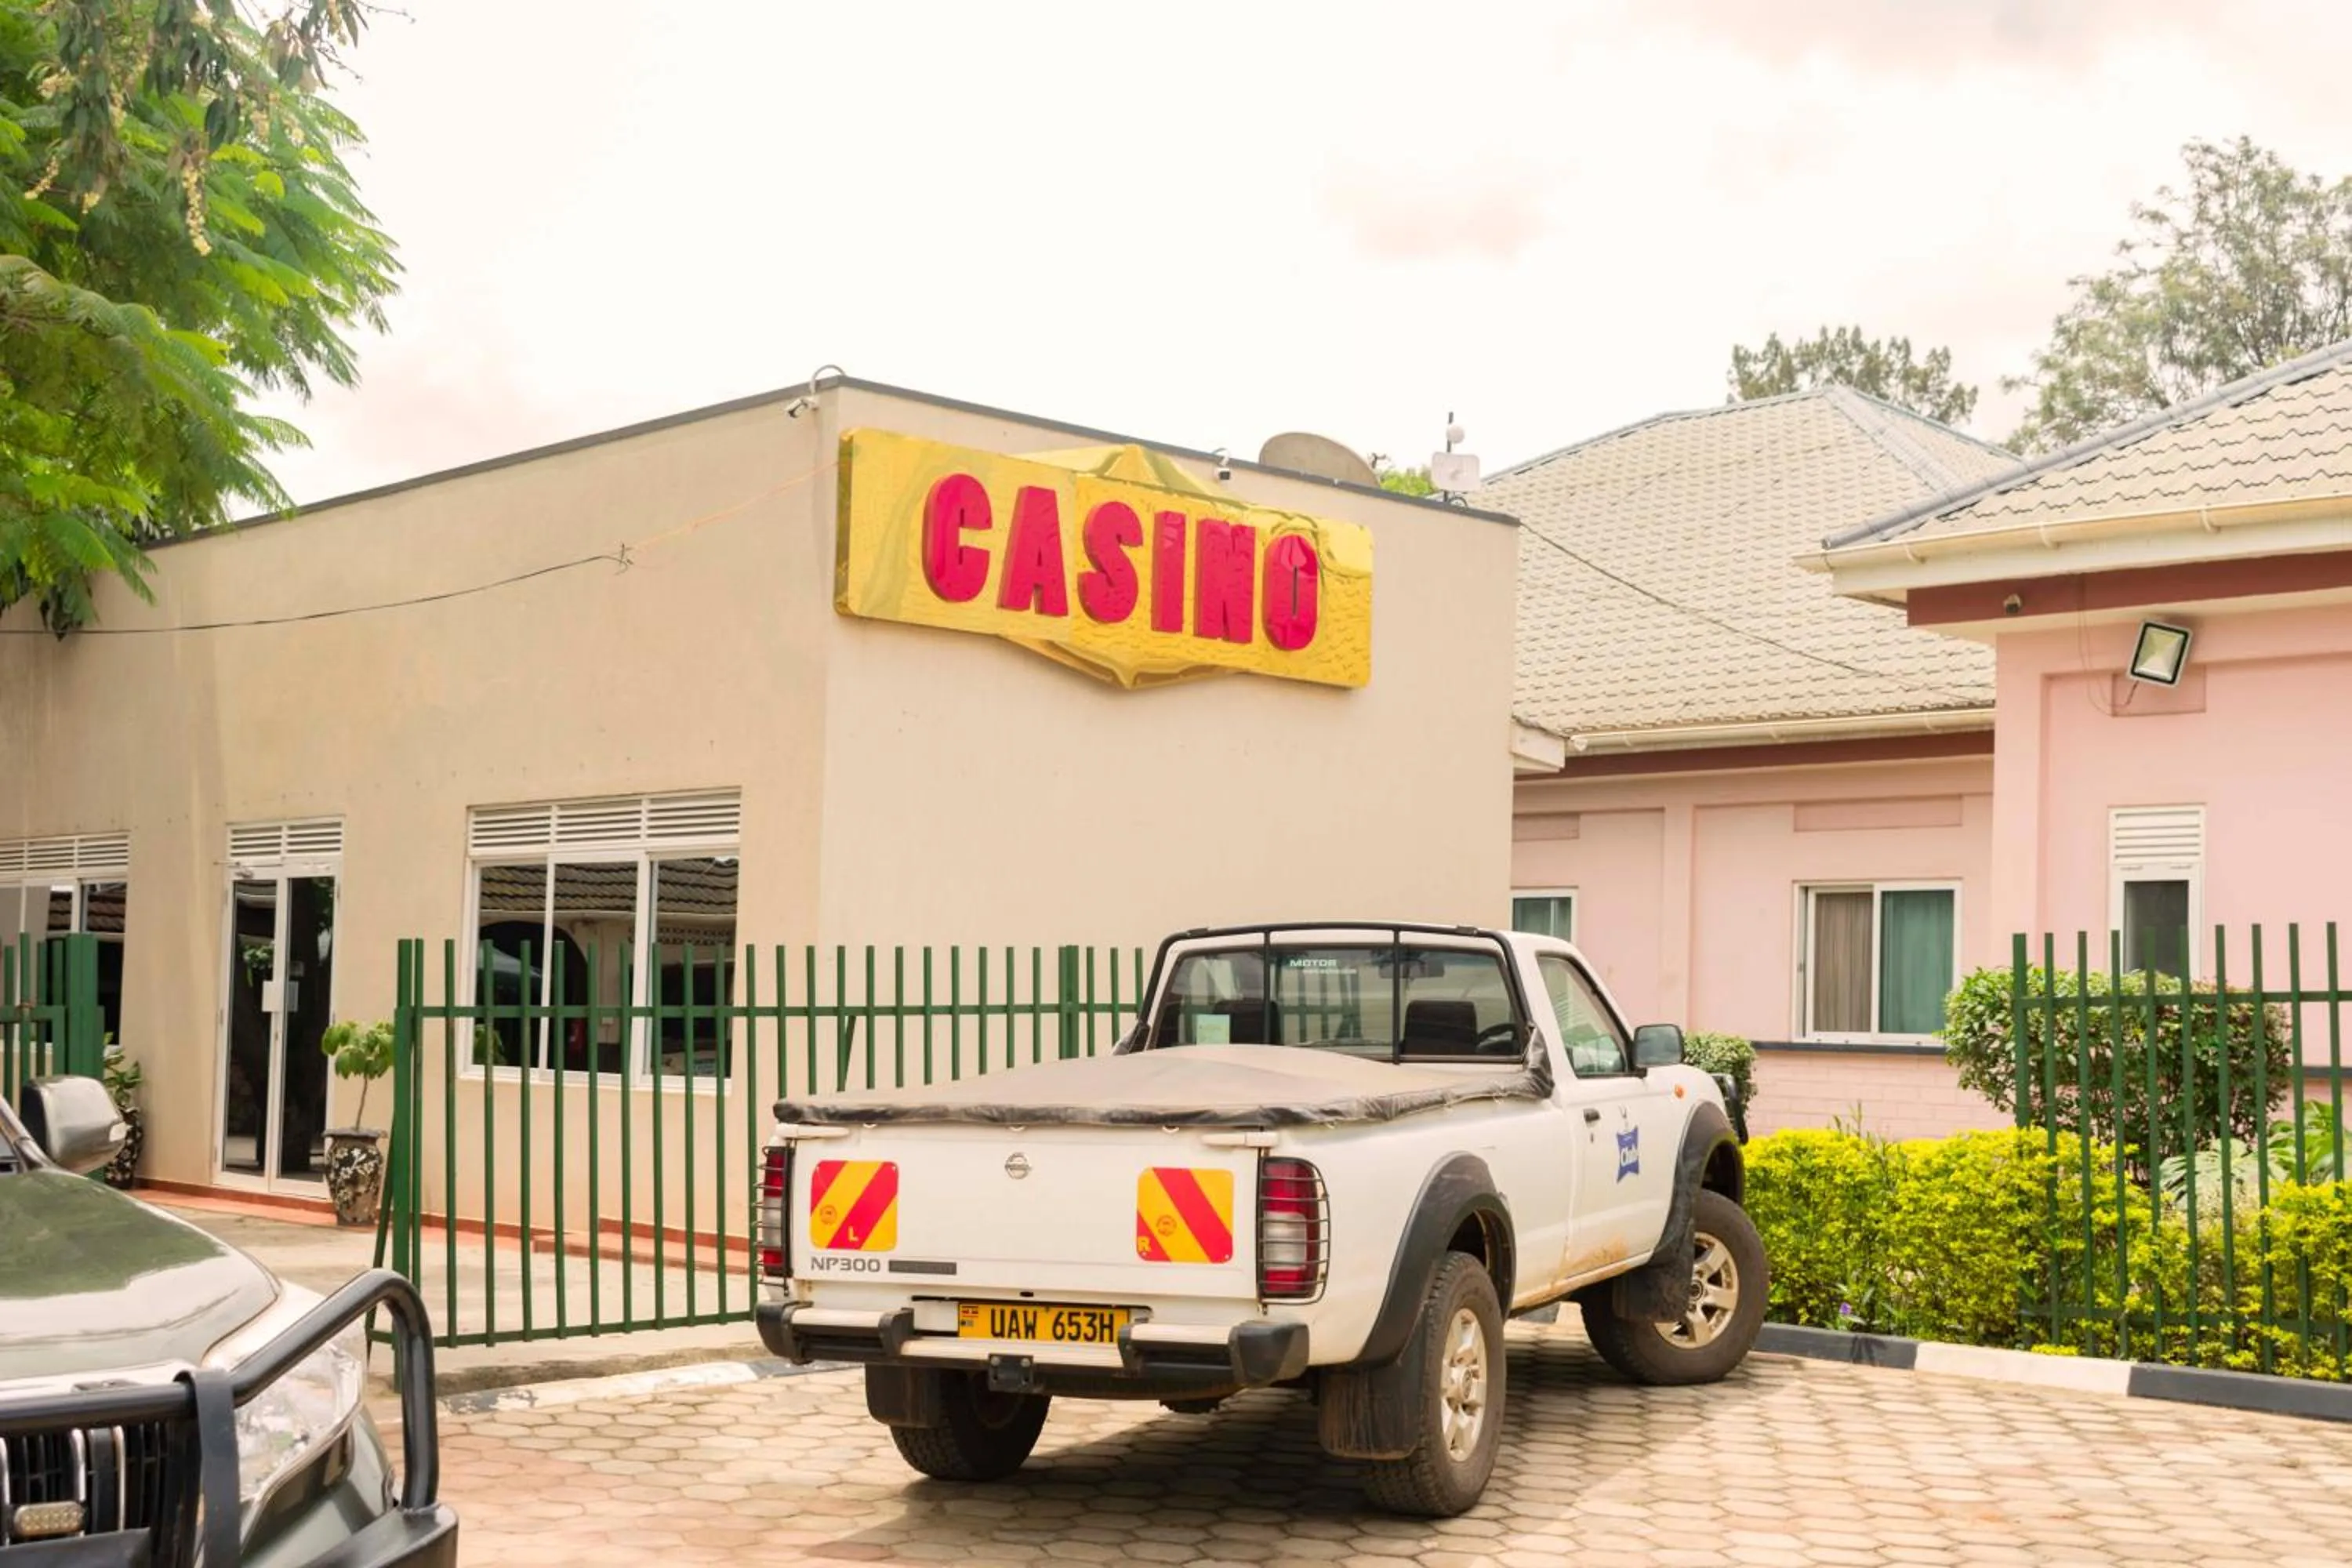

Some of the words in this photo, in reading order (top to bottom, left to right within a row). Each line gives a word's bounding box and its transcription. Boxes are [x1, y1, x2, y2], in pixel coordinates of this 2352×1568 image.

[920, 472, 1319, 652] CASINO
[848, 1225, 859, 1242] L
[1138, 1236, 1152, 1252] R
[811, 1257, 880, 1272] NP300
[990, 1308, 1037, 1340] UAW
[1051, 1311, 1114, 1343] 653H
